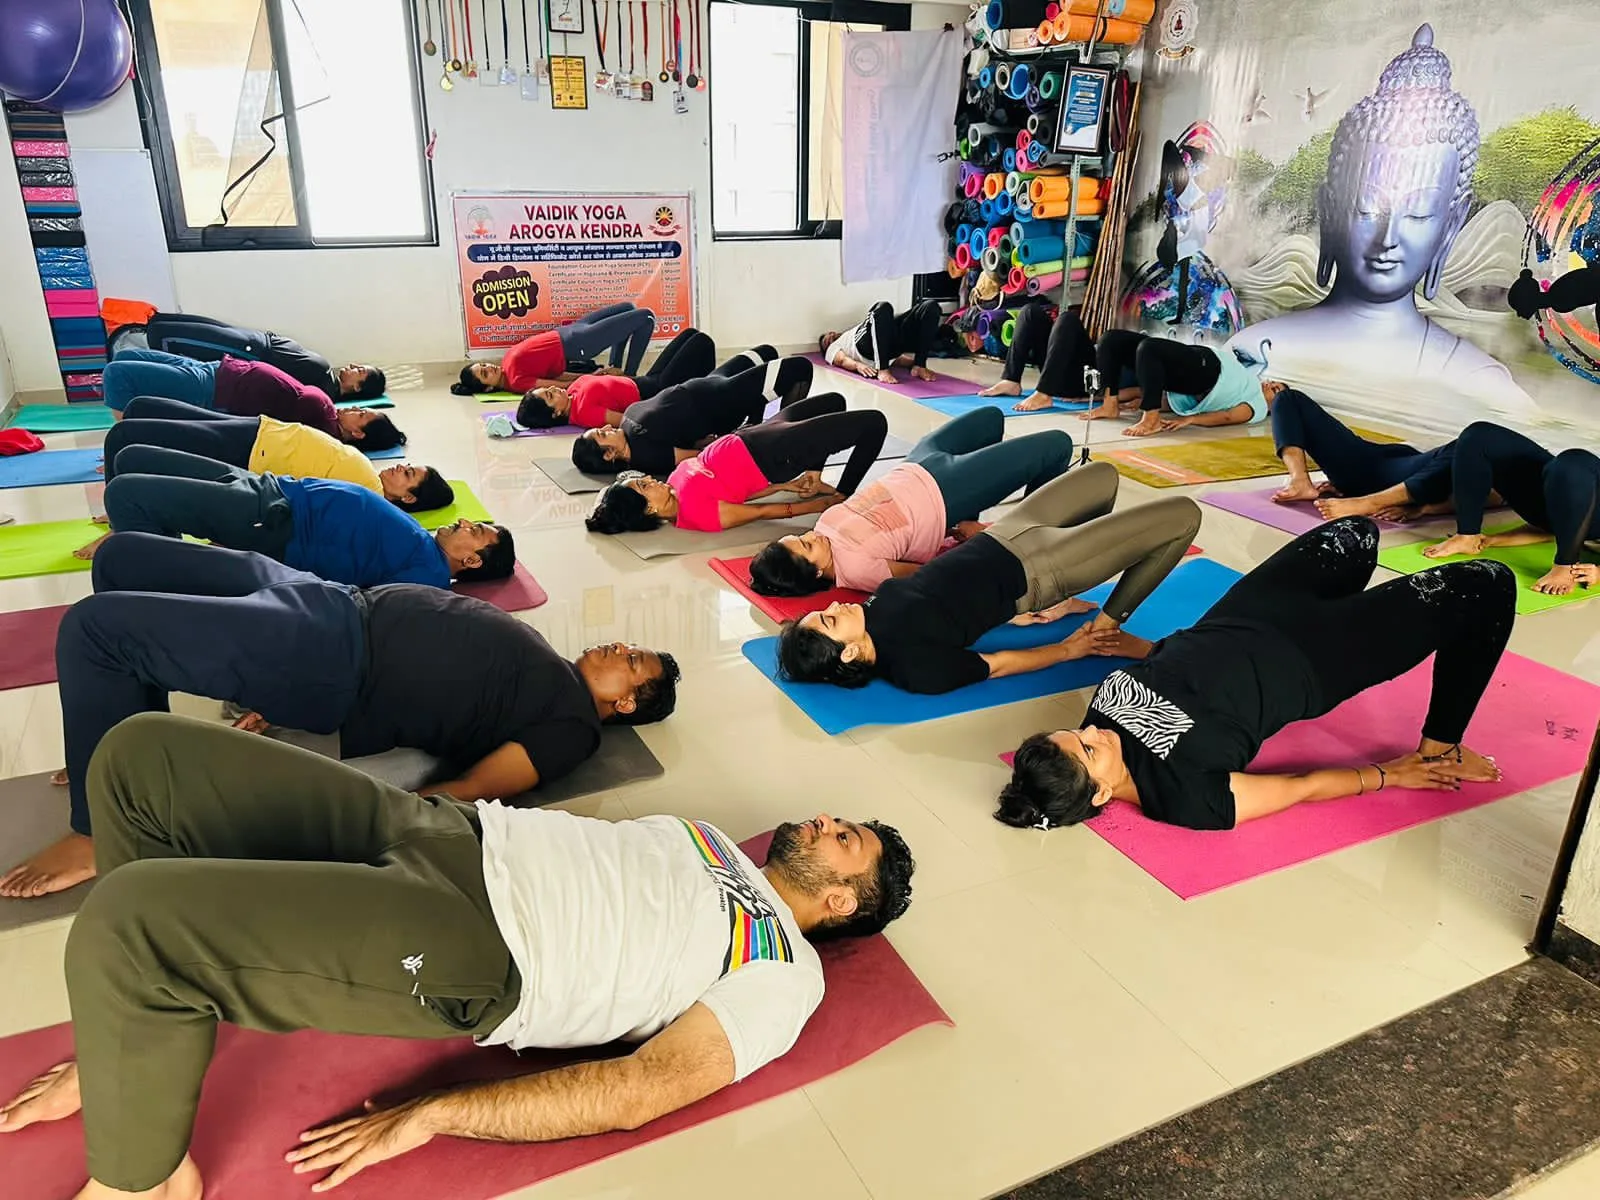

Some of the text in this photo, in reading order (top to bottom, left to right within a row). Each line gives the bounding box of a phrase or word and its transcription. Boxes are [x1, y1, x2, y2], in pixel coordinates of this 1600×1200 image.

[524, 204, 627, 220] VAIDIK YOGA
[509, 223, 576, 239] AROGYA
[580, 223, 643, 239] KENDRA
[476, 276, 531, 312] ADMISSION OPEN
